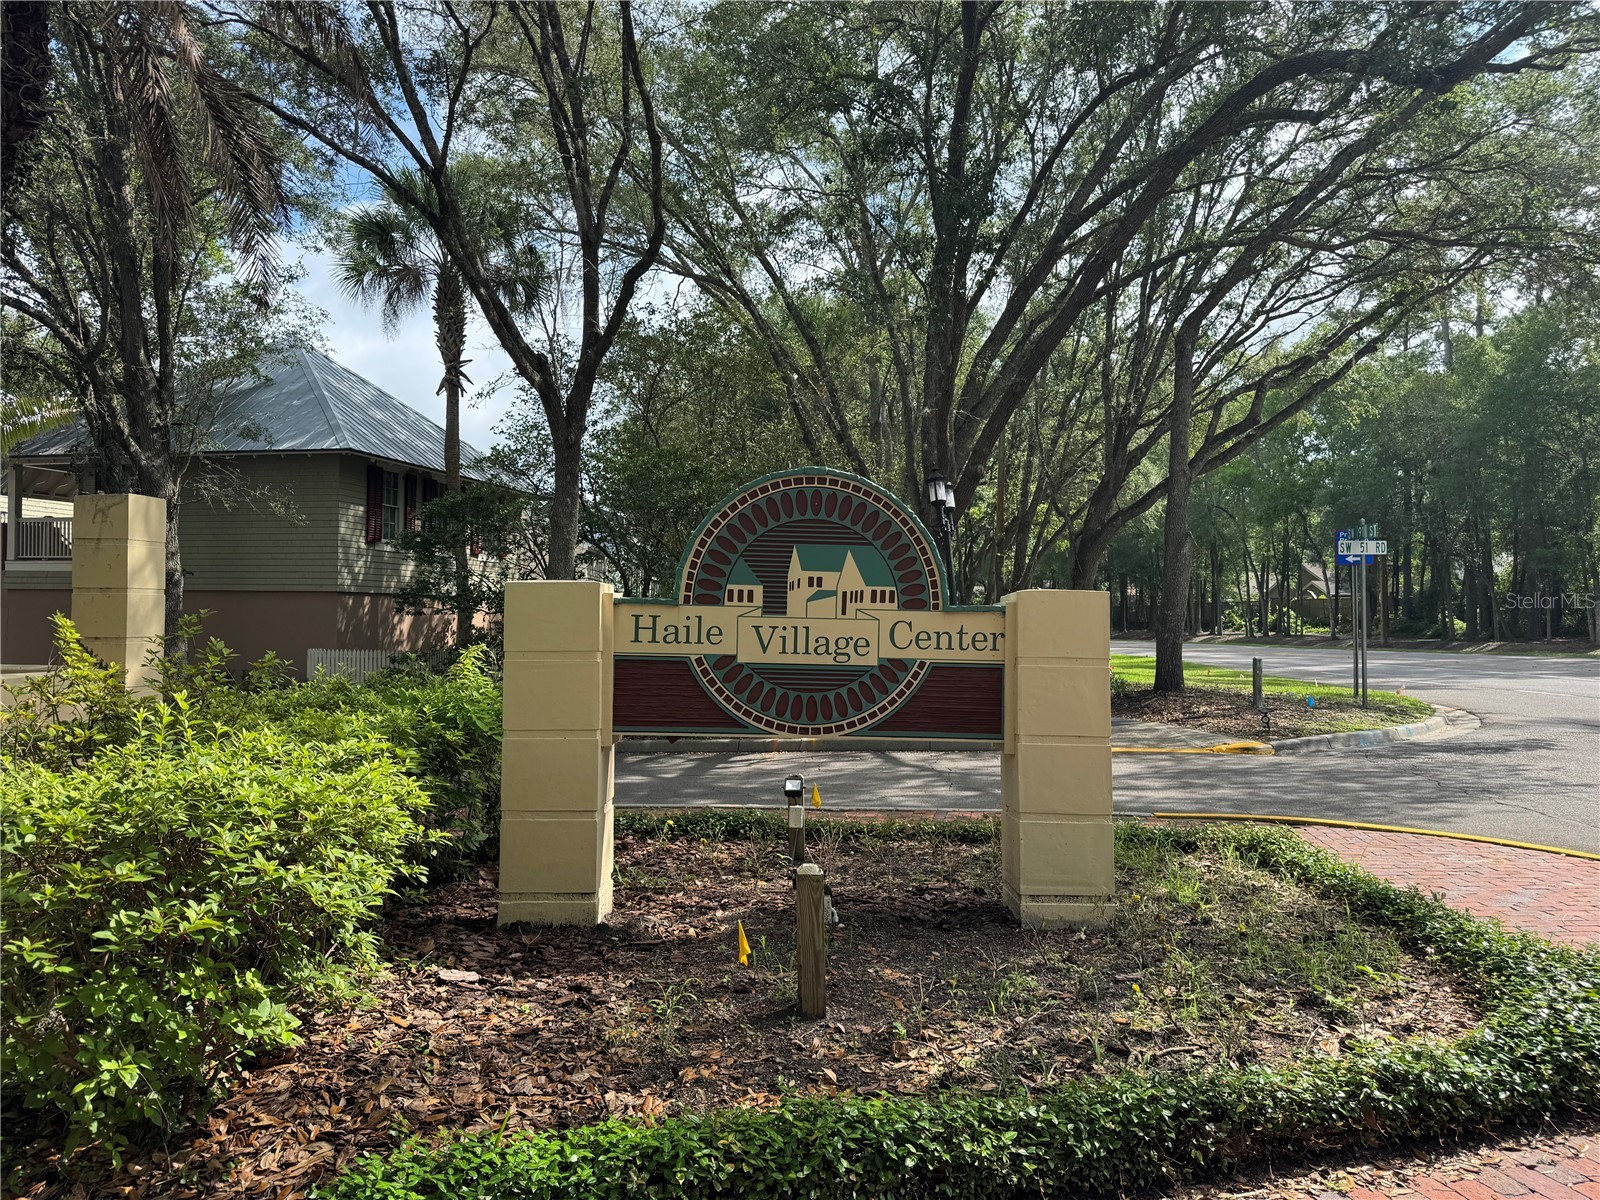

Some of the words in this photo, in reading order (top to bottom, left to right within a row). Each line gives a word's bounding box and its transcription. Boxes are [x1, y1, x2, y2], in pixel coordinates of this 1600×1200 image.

[1340, 542, 1352, 553] SW
[1360, 542, 1368, 553] 51
[1376, 542, 1386, 553] RD
[630, 614, 724, 646] Haile
[751, 625, 871, 664] Village
[889, 620, 1005, 652] Center
